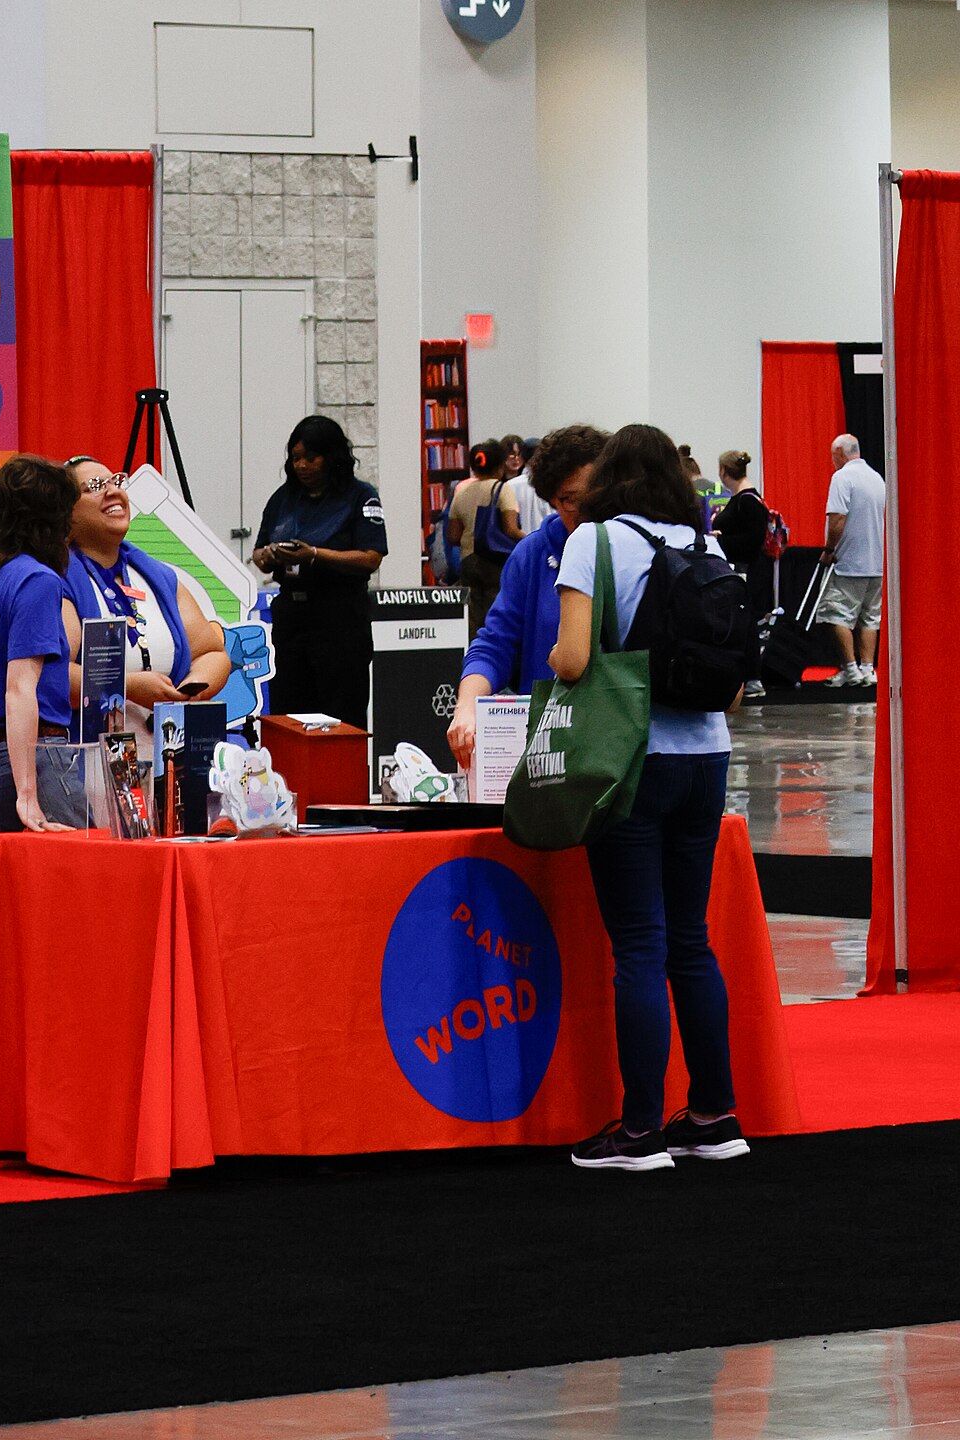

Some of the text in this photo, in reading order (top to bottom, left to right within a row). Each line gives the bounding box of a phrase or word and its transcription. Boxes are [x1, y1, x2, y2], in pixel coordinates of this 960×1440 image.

[376, 589, 461, 605] LANDFILL ONLY
[398, 627, 437, 640] LANDFILL
[414, 978, 537, 1065] WORD
